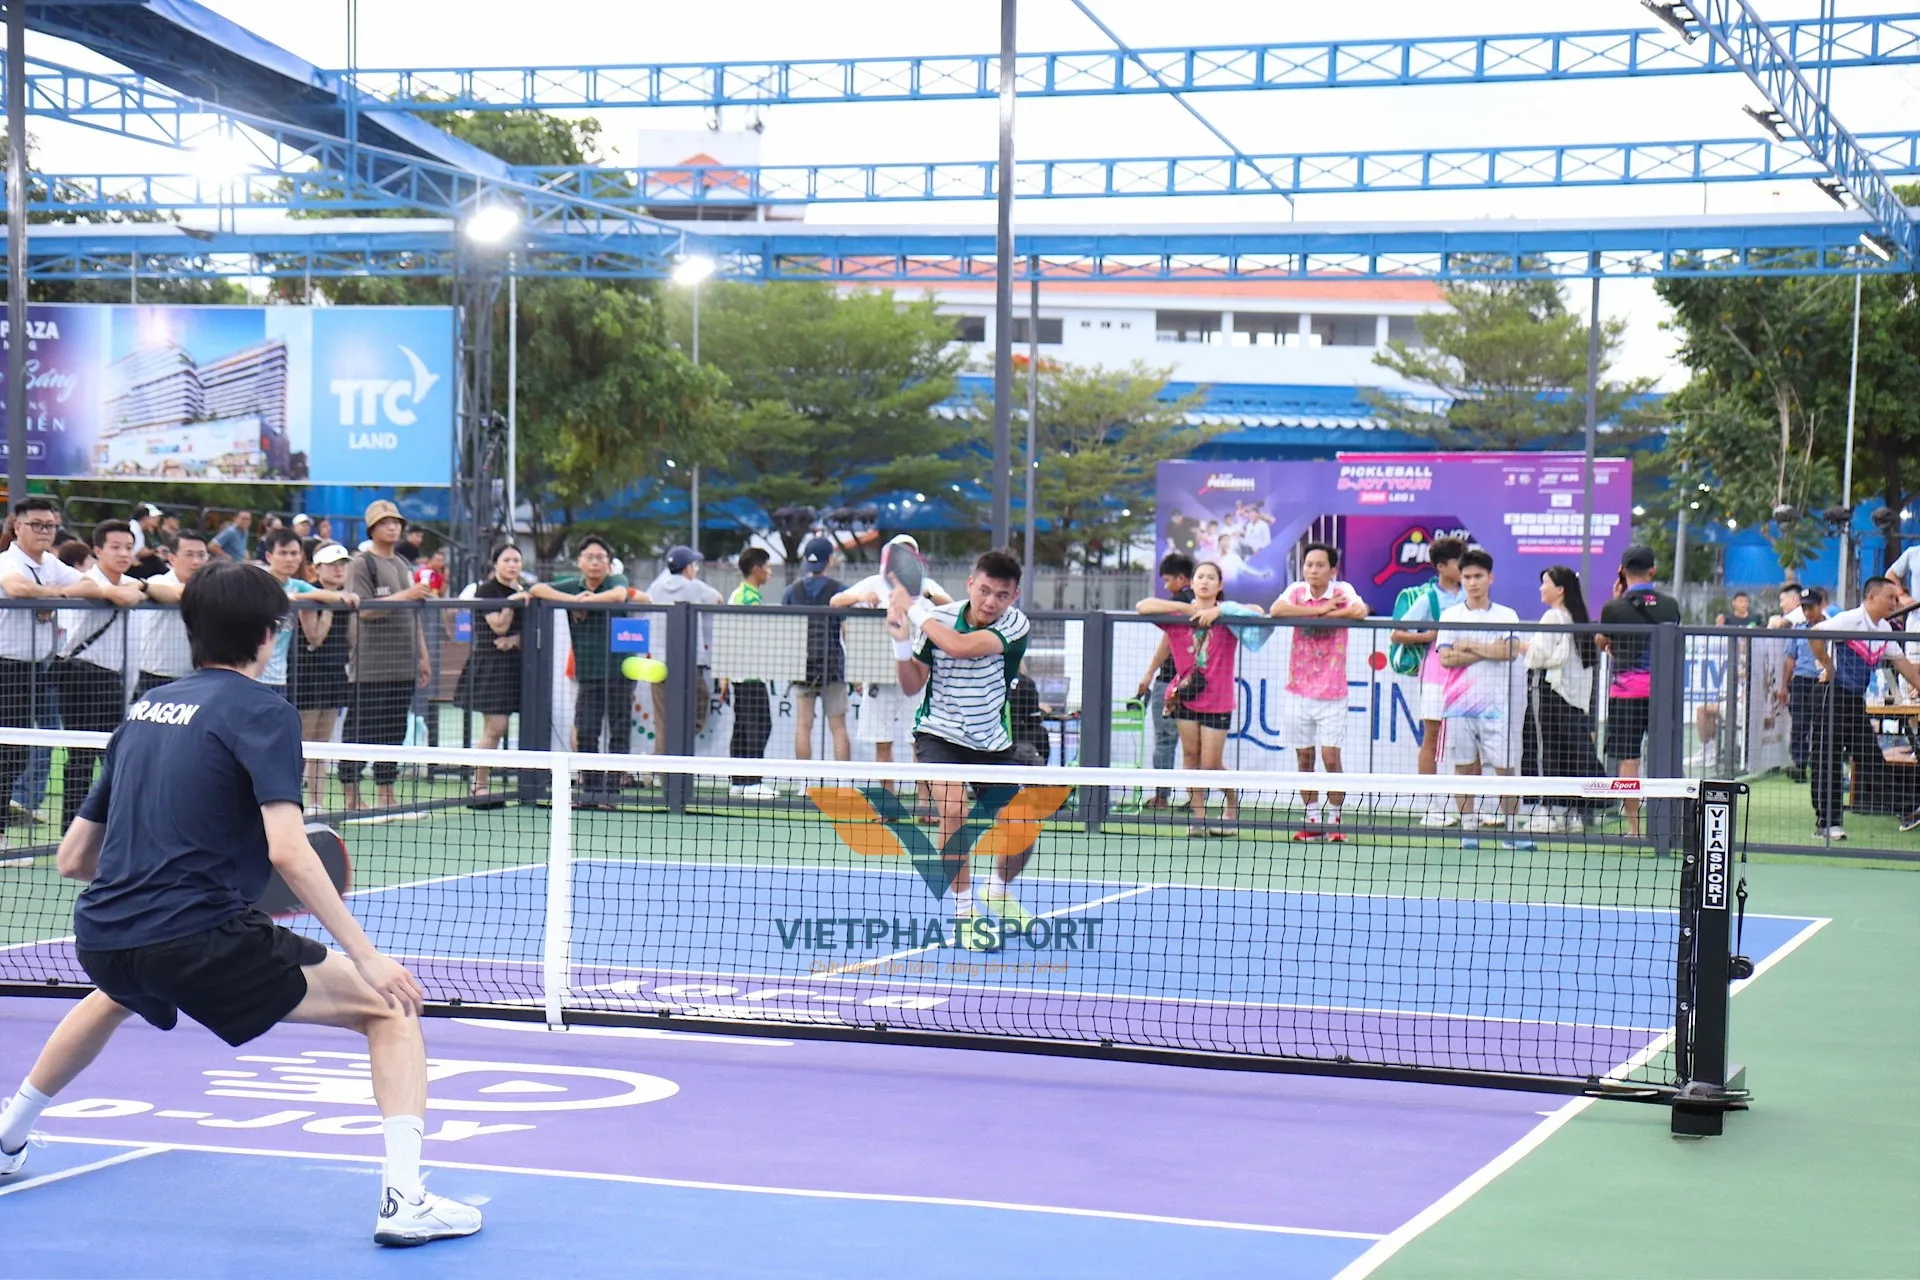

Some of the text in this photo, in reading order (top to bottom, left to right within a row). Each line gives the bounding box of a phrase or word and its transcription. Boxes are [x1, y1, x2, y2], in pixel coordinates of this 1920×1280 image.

[0, 320, 60, 340] PAZA
[329, 379, 419, 426] TTC
[348, 431, 399, 450] LAND
[1340, 465, 1433, 478] PICKLEBALL
[40, 1097, 537, 1141] D-JOY
